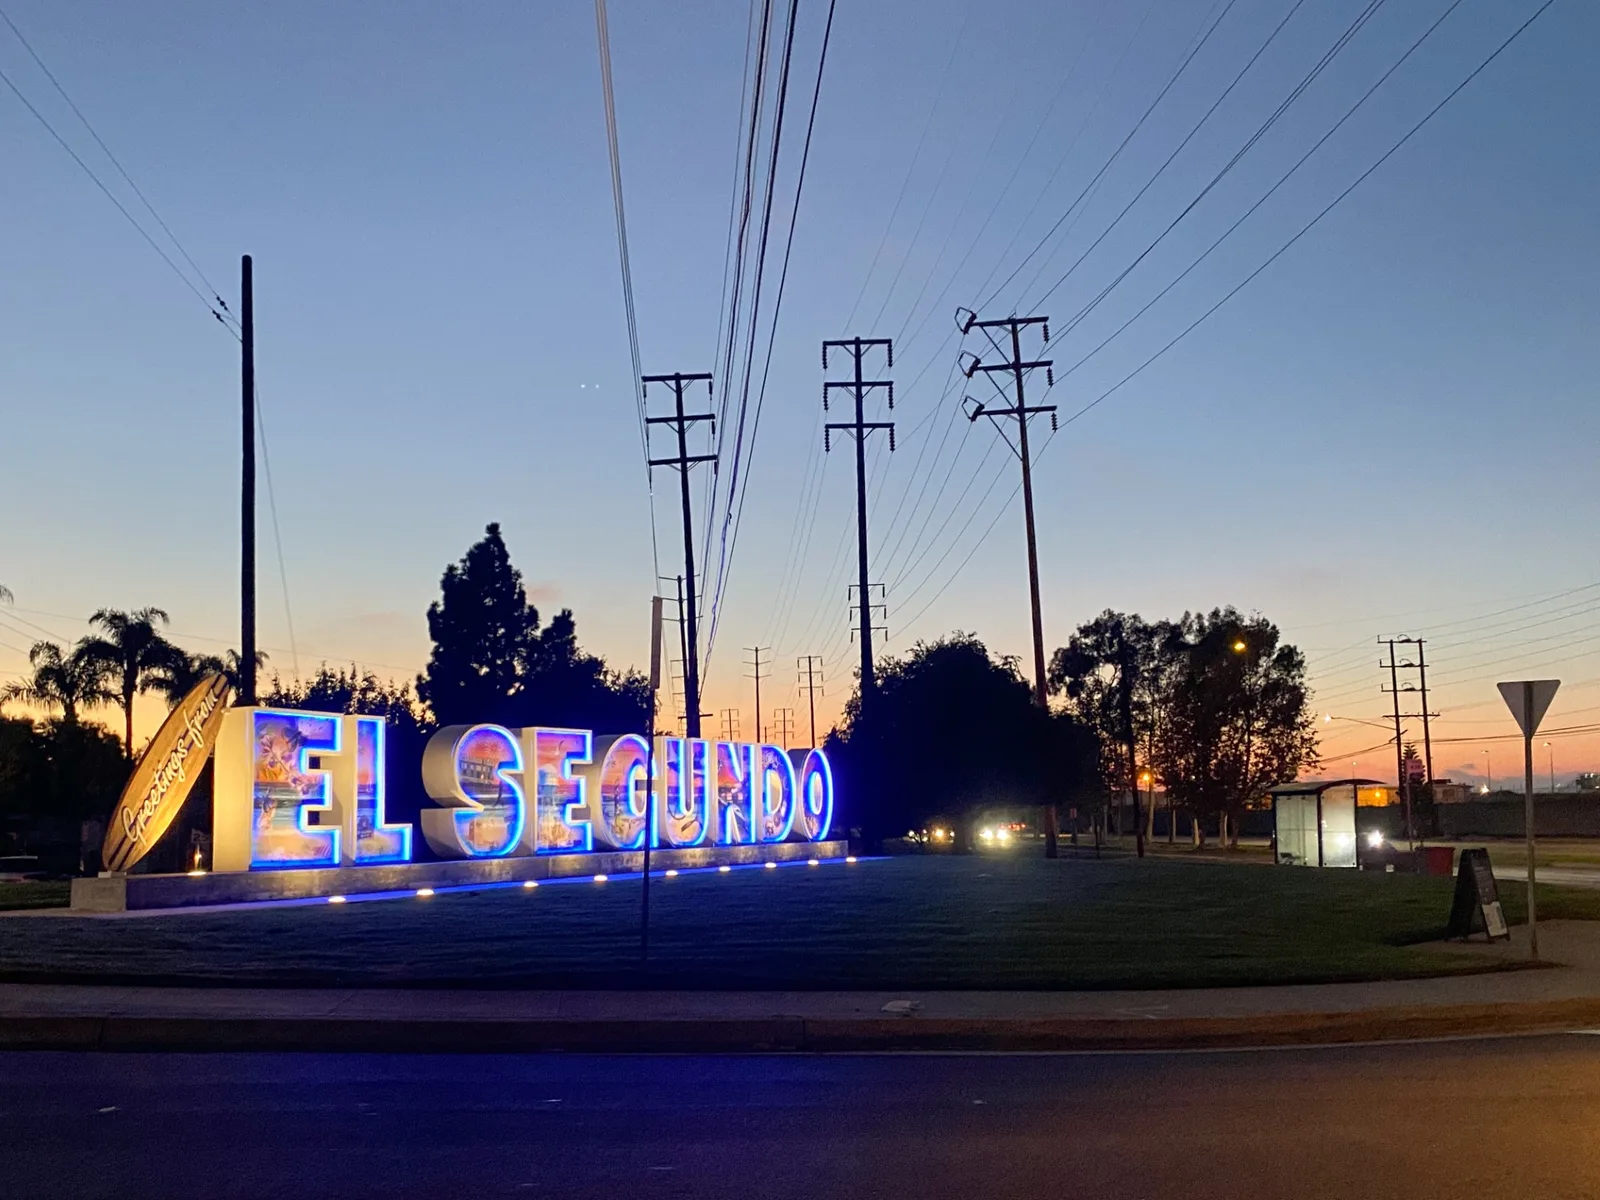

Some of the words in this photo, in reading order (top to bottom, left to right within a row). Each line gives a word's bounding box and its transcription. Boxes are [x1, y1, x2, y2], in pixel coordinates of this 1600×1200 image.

[121, 739, 188, 845] Greetings
[184, 688, 218, 748] from
[246, 705, 412, 871] EL
[446, 723, 834, 858] SEGUNDO
